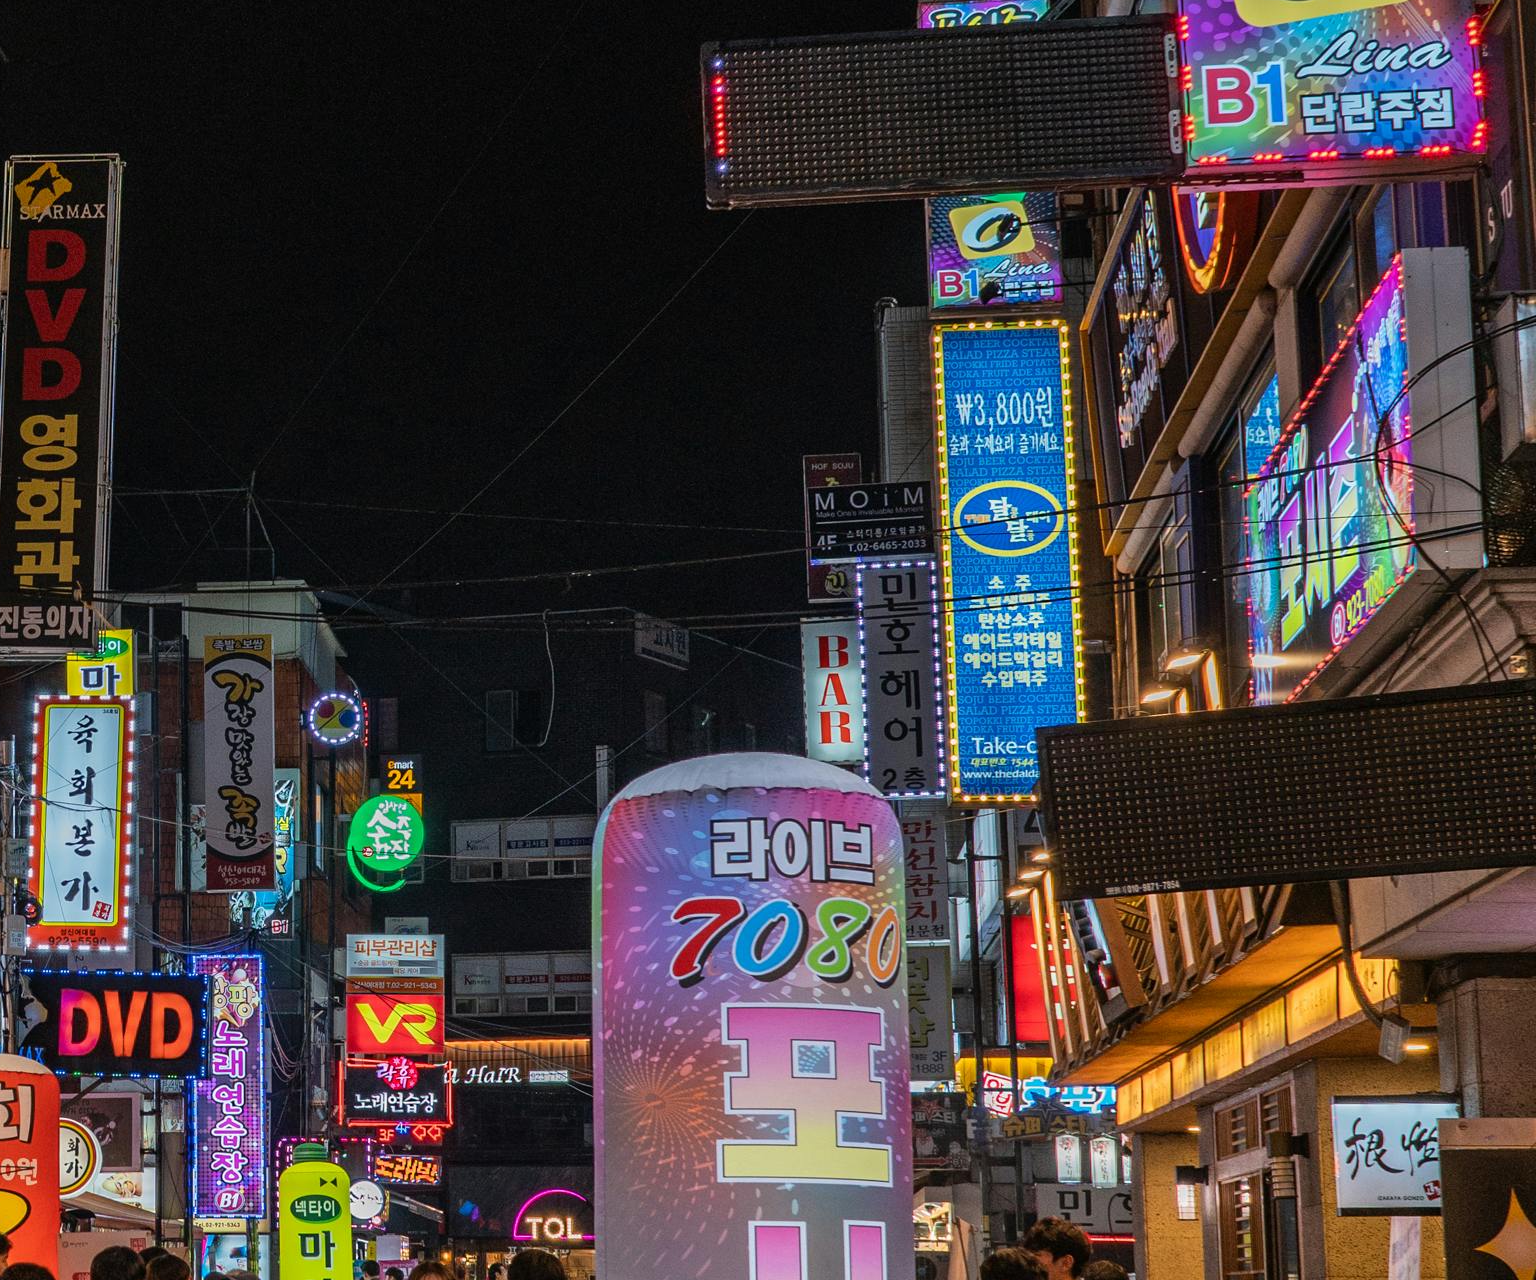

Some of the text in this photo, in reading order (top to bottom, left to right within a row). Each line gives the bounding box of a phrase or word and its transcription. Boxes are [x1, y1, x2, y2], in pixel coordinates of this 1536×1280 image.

[1202, 63, 1455, 136] B1 단란주점
[937, 267, 980, 299] B1
[13, 228, 87, 591] DVD 영화관
[955, 385, 1054, 433] ₩3,800원
[949, 432, 970, 457] 술과
[973, 432, 1015, 456] 수제요리
[848, 539, 927, 553] T.02-6465-2033
[978, 611, 1045, 630] 탄산소주
[962, 631, 1063, 651] 에이드칵테일
[877, 572, 923, 759] 민호헤어
[962, 650, 1064, 669] 에이드막걸리
[815, 634, 852, 746] BAR
[980, 669, 1048, 688] 수입맥주
[387, 760, 414, 770] emart
[882, 765, 925, 790] 2층
[387, 769, 416, 790] 24
[60, 714, 99, 912] 육회본가
[710, 818, 876, 885] 라이브
[354, 939, 438, 957] 피부관리샵
[671, 896, 902, 984] 7080
[58, 987, 195, 1061] DVD
[355, 1001, 438, 1046] VR
[932, 1051, 948, 1062] 3F
[211, 1020, 249, 1184] 노래연습장
[353, 1092, 438, 1114] 노래연습장
[379, 1128, 395, 1141] 3F
[219, 1192, 240, 1209] B1
[292, 1198, 338, 1218] 넥타이
